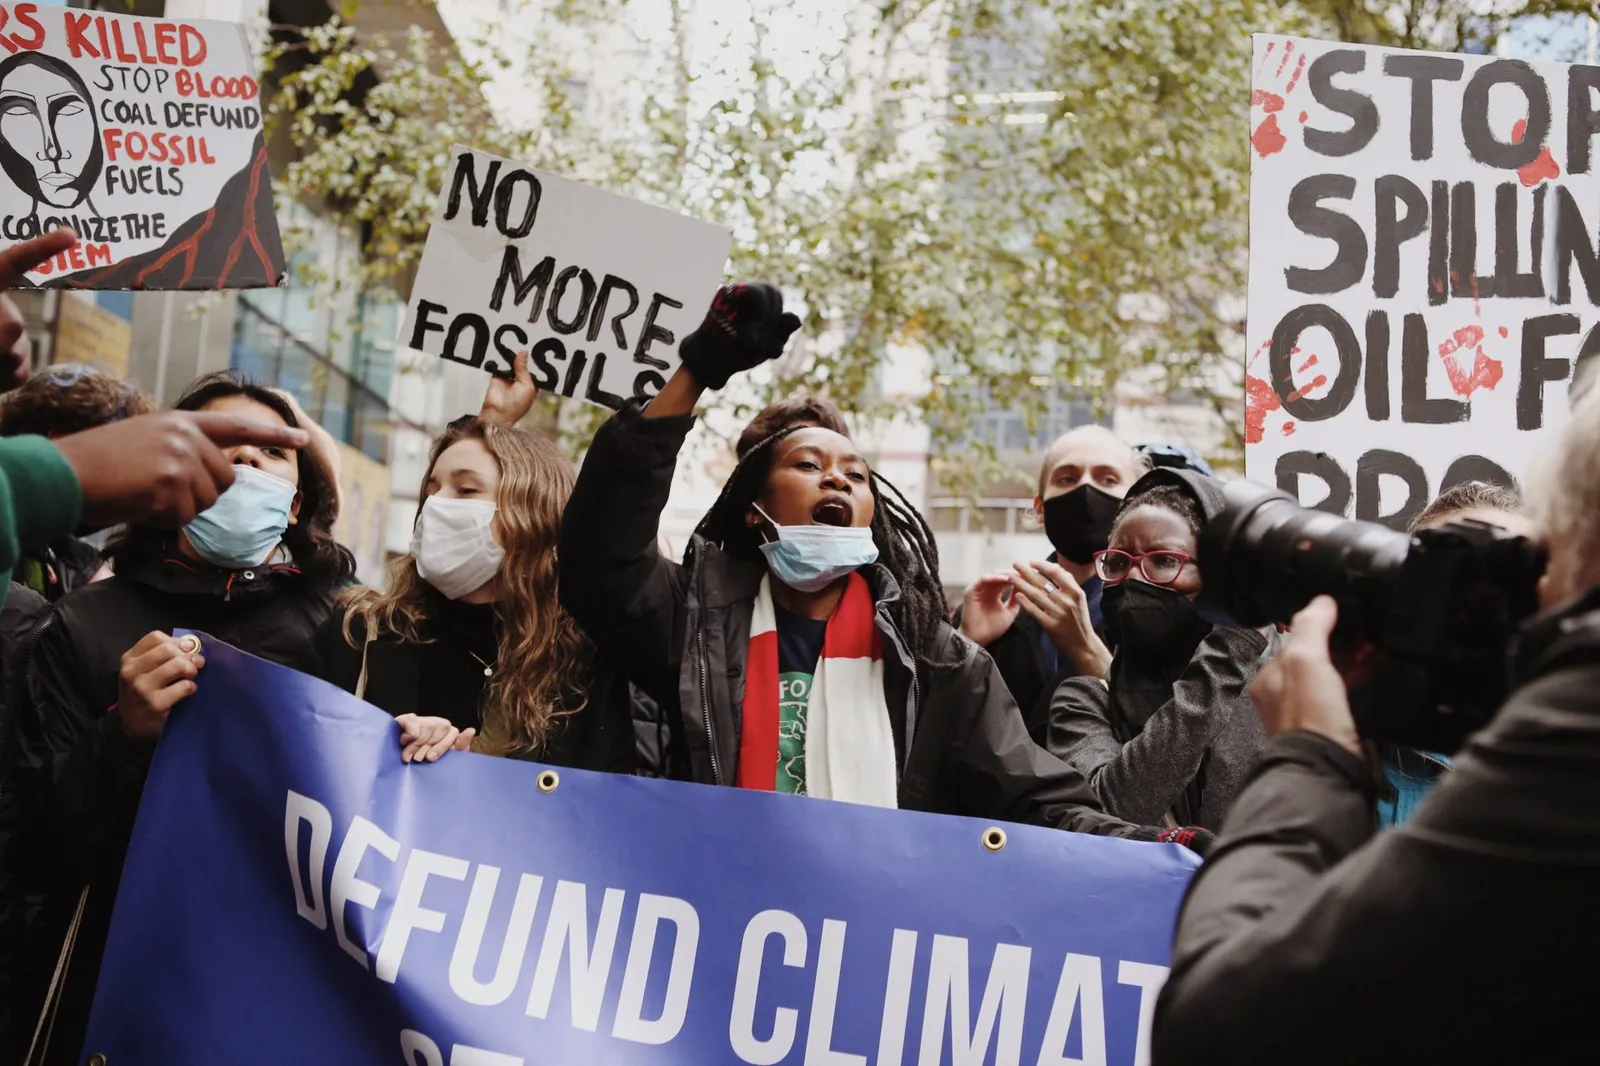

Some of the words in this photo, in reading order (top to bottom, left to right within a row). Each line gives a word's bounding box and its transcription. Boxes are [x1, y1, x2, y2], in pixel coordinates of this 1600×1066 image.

[64, 11, 208, 67] KILLED
[93, 64, 169, 94] STOP
[175, 68, 258, 100] BLOOD
[101, 98, 158, 126] COAL
[163, 101, 260, 129] DEFUND
[103, 128, 216, 166] FOSSIL
[105, 165, 184, 197] FUELS
[443, 152, 543, 239] NO
[121, 212, 167, 240] THE
[488, 244, 684, 371] MORE
[1268, 303, 1472, 424] OIL
[779, 679, 809, 699] FO
[284, 788, 701, 1046] DEFUND
